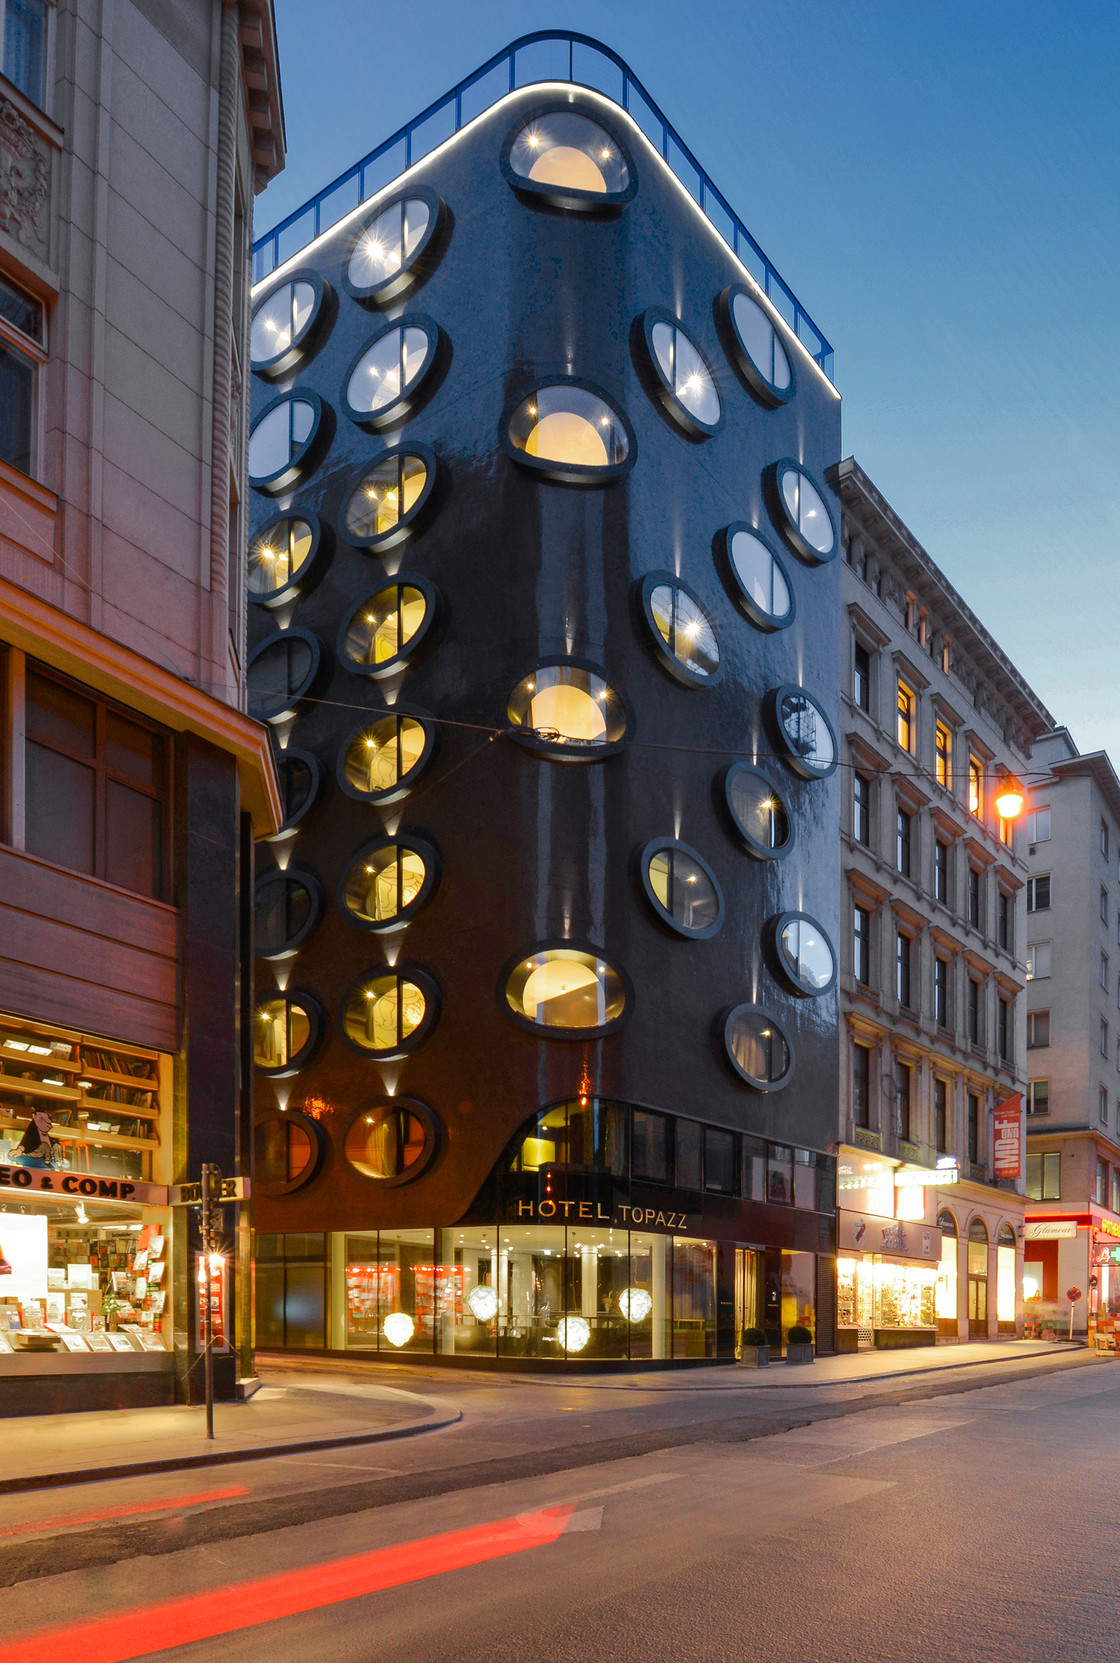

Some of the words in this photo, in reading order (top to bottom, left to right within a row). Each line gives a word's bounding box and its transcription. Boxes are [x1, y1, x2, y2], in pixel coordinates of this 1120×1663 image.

[40, 1176, 54, 1190] &
[61, 1176, 136, 1201] COMP.
[518, 1200, 610, 1219] HOTEL
[617, 1204, 688, 1229] TOPAZZ
